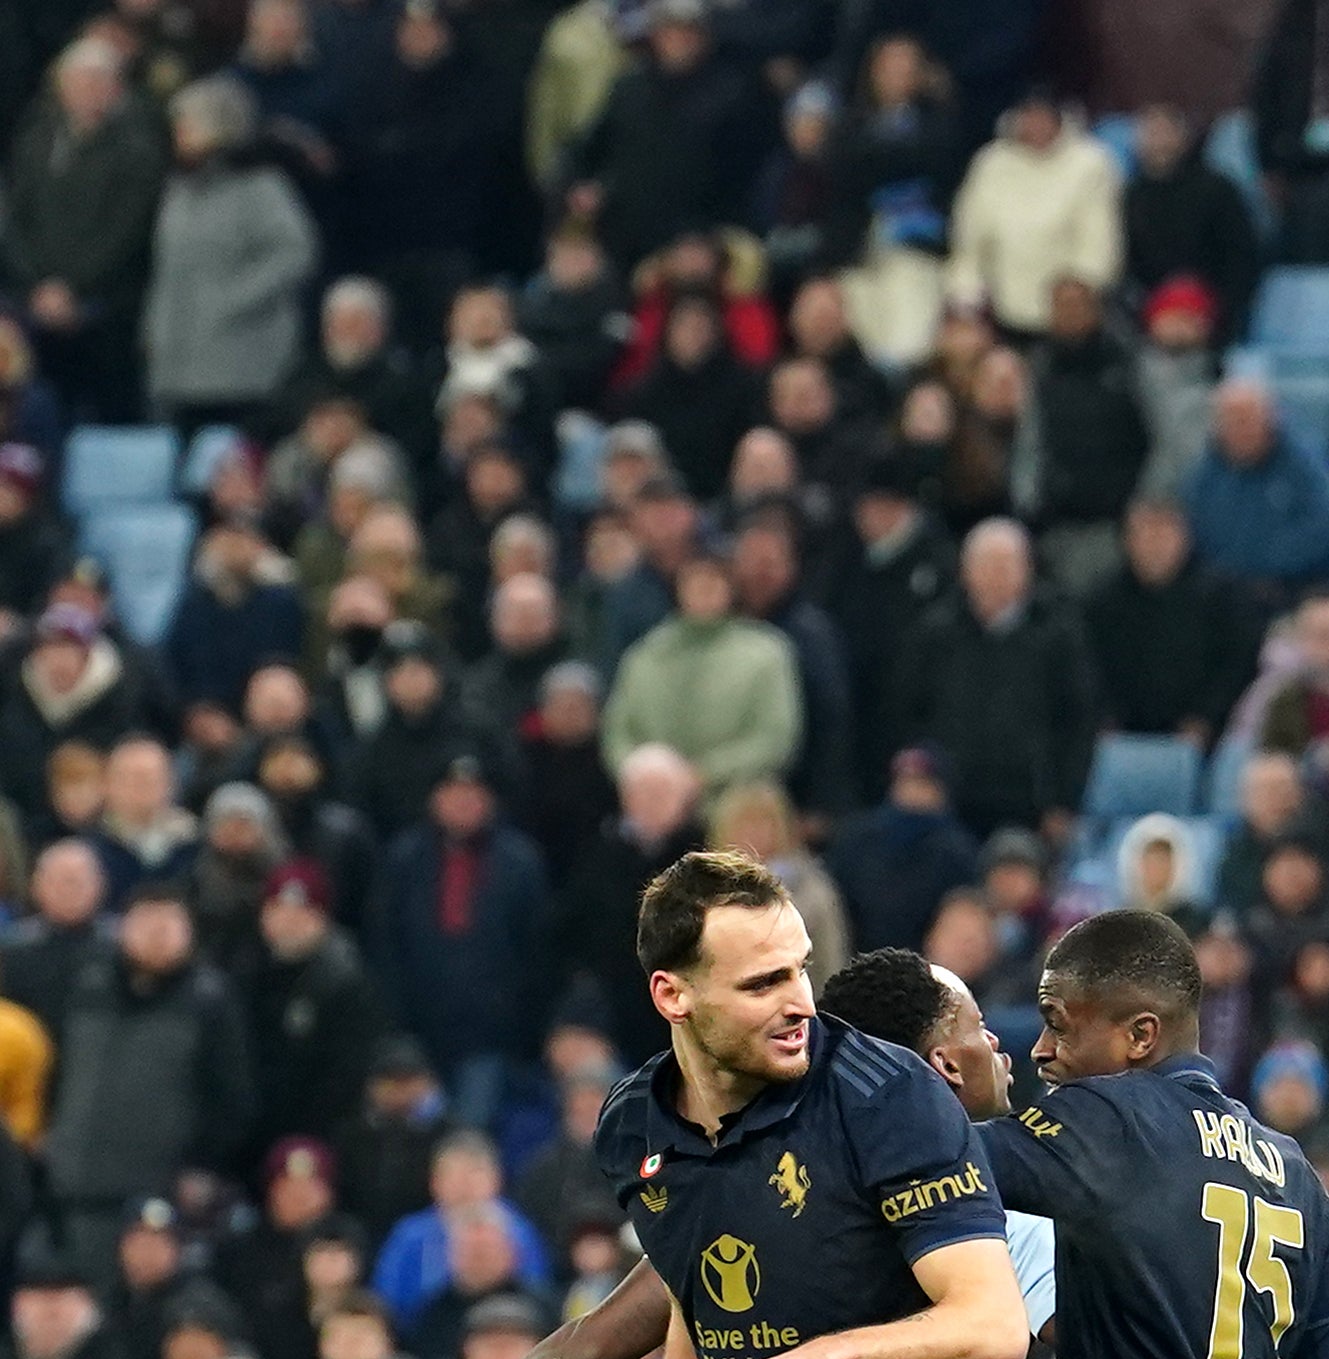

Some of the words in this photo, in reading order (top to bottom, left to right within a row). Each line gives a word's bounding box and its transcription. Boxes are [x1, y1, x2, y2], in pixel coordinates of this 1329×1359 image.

[881, 1162, 988, 1222] azimut
[695, 1320, 745, 1350] Save
[750, 1320, 800, 1349] the
